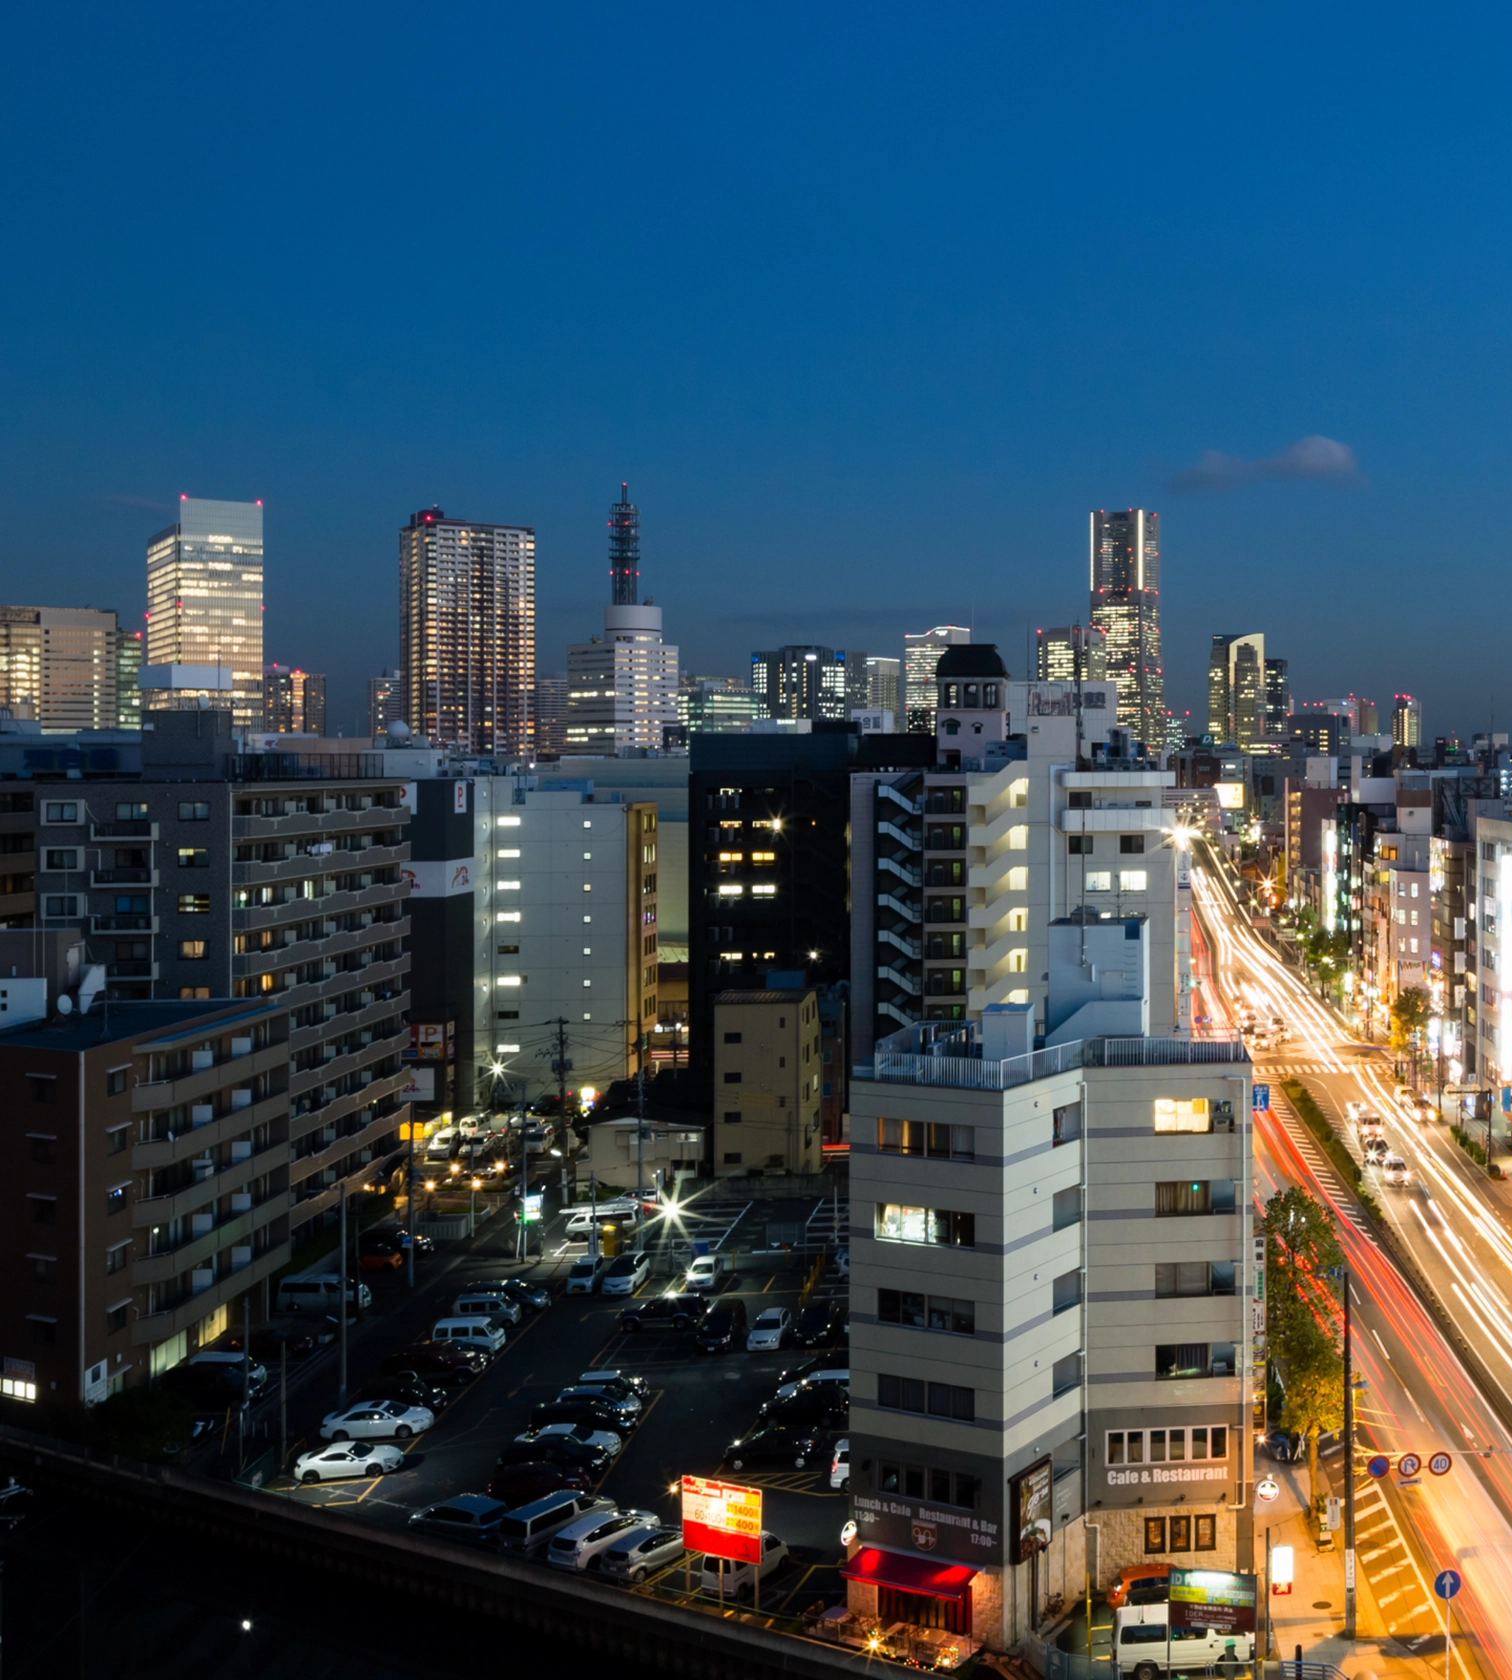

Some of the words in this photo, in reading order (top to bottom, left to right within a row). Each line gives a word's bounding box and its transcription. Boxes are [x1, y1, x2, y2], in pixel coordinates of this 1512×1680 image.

[425, 1027, 437, 1041] P
[1433, 1457, 1447, 1470] 40
[1107, 1470, 1139, 1485] Cafe
[1141, 1471, 1151, 1483] &
[1153, 1466, 1228, 1483] Restaurant
[854, 1495, 881, 1511] Lunch
[882, 1502, 889, 1512] &
[890, 1502, 911, 1517] Cafe
[919, 1507, 971, 1529] Restaurant
[972, 1519, 979, 1530] &
[980, 1520, 998, 1535] Bar
[1171, 1573, 1182, 1585] ID
